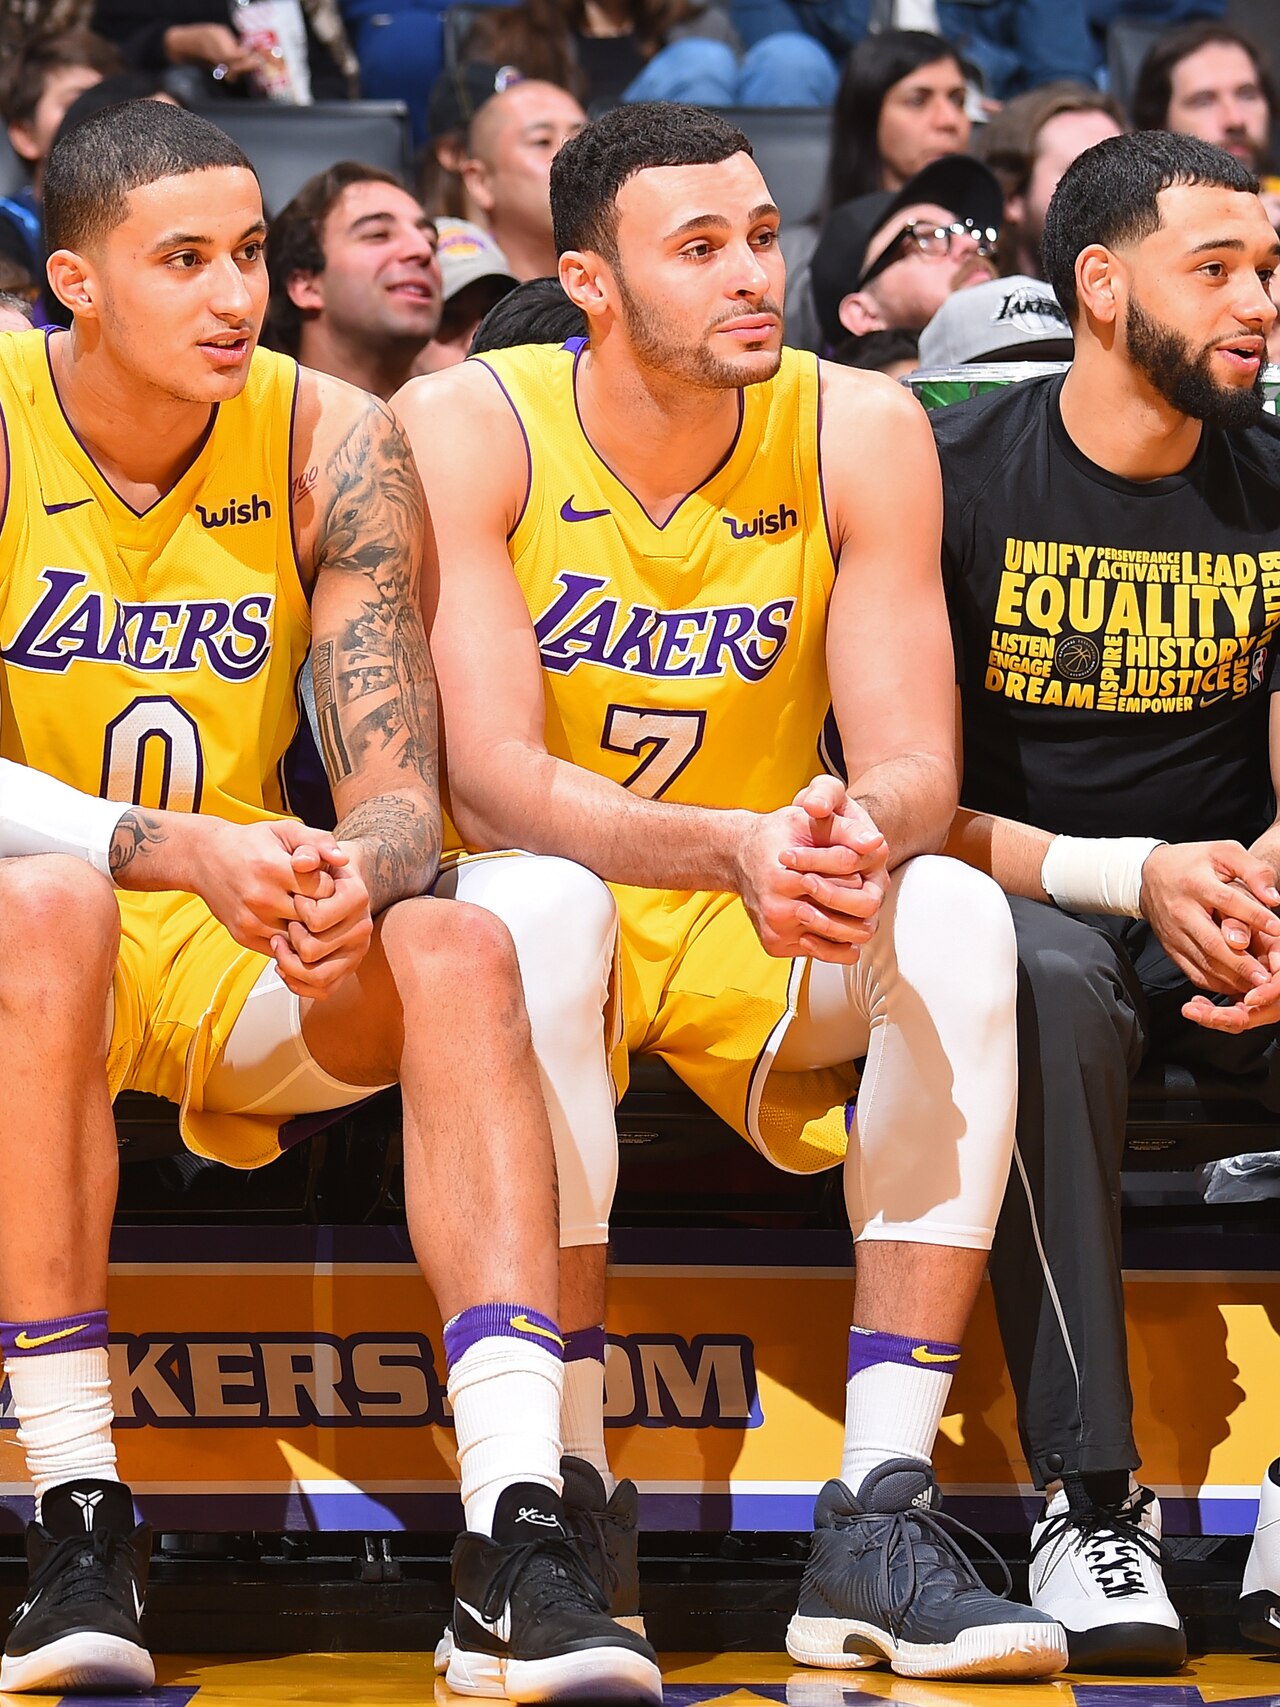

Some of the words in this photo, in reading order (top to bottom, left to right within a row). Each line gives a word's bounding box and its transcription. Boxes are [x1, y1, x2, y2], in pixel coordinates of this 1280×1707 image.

[195, 494, 272, 529] wish
[722, 503, 798, 539] wish
[1004, 537, 1096, 579] UNIFY
[1096, 560, 1180, 583] ACTIVATE
[1097, 547, 1180, 564] PERSEVERANCE
[1182, 552, 1257, 586] LEAD
[994, 571, 1258, 638] EQUALITY
[0, 565, 277, 684] LAKERS
[534, 569, 798, 684] LAKERS
[990, 630, 1056, 659] LISTEN
[1125, 635, 1257, 669] HISTORY
[988, 651, 1053, 678] ENGAGE
[1097, 634, 1123, 712] INSPIRE
[1120, 664, 1231, 698] JUSTICE
[1231, 655, 1250, 701] LOVE
[984, 666, 1095, 709] DREAM
[1117, 697, 1194, 714] EMPOWER
[99, 695, 205, 814] 0
[600, 703, 708, 801] 7
